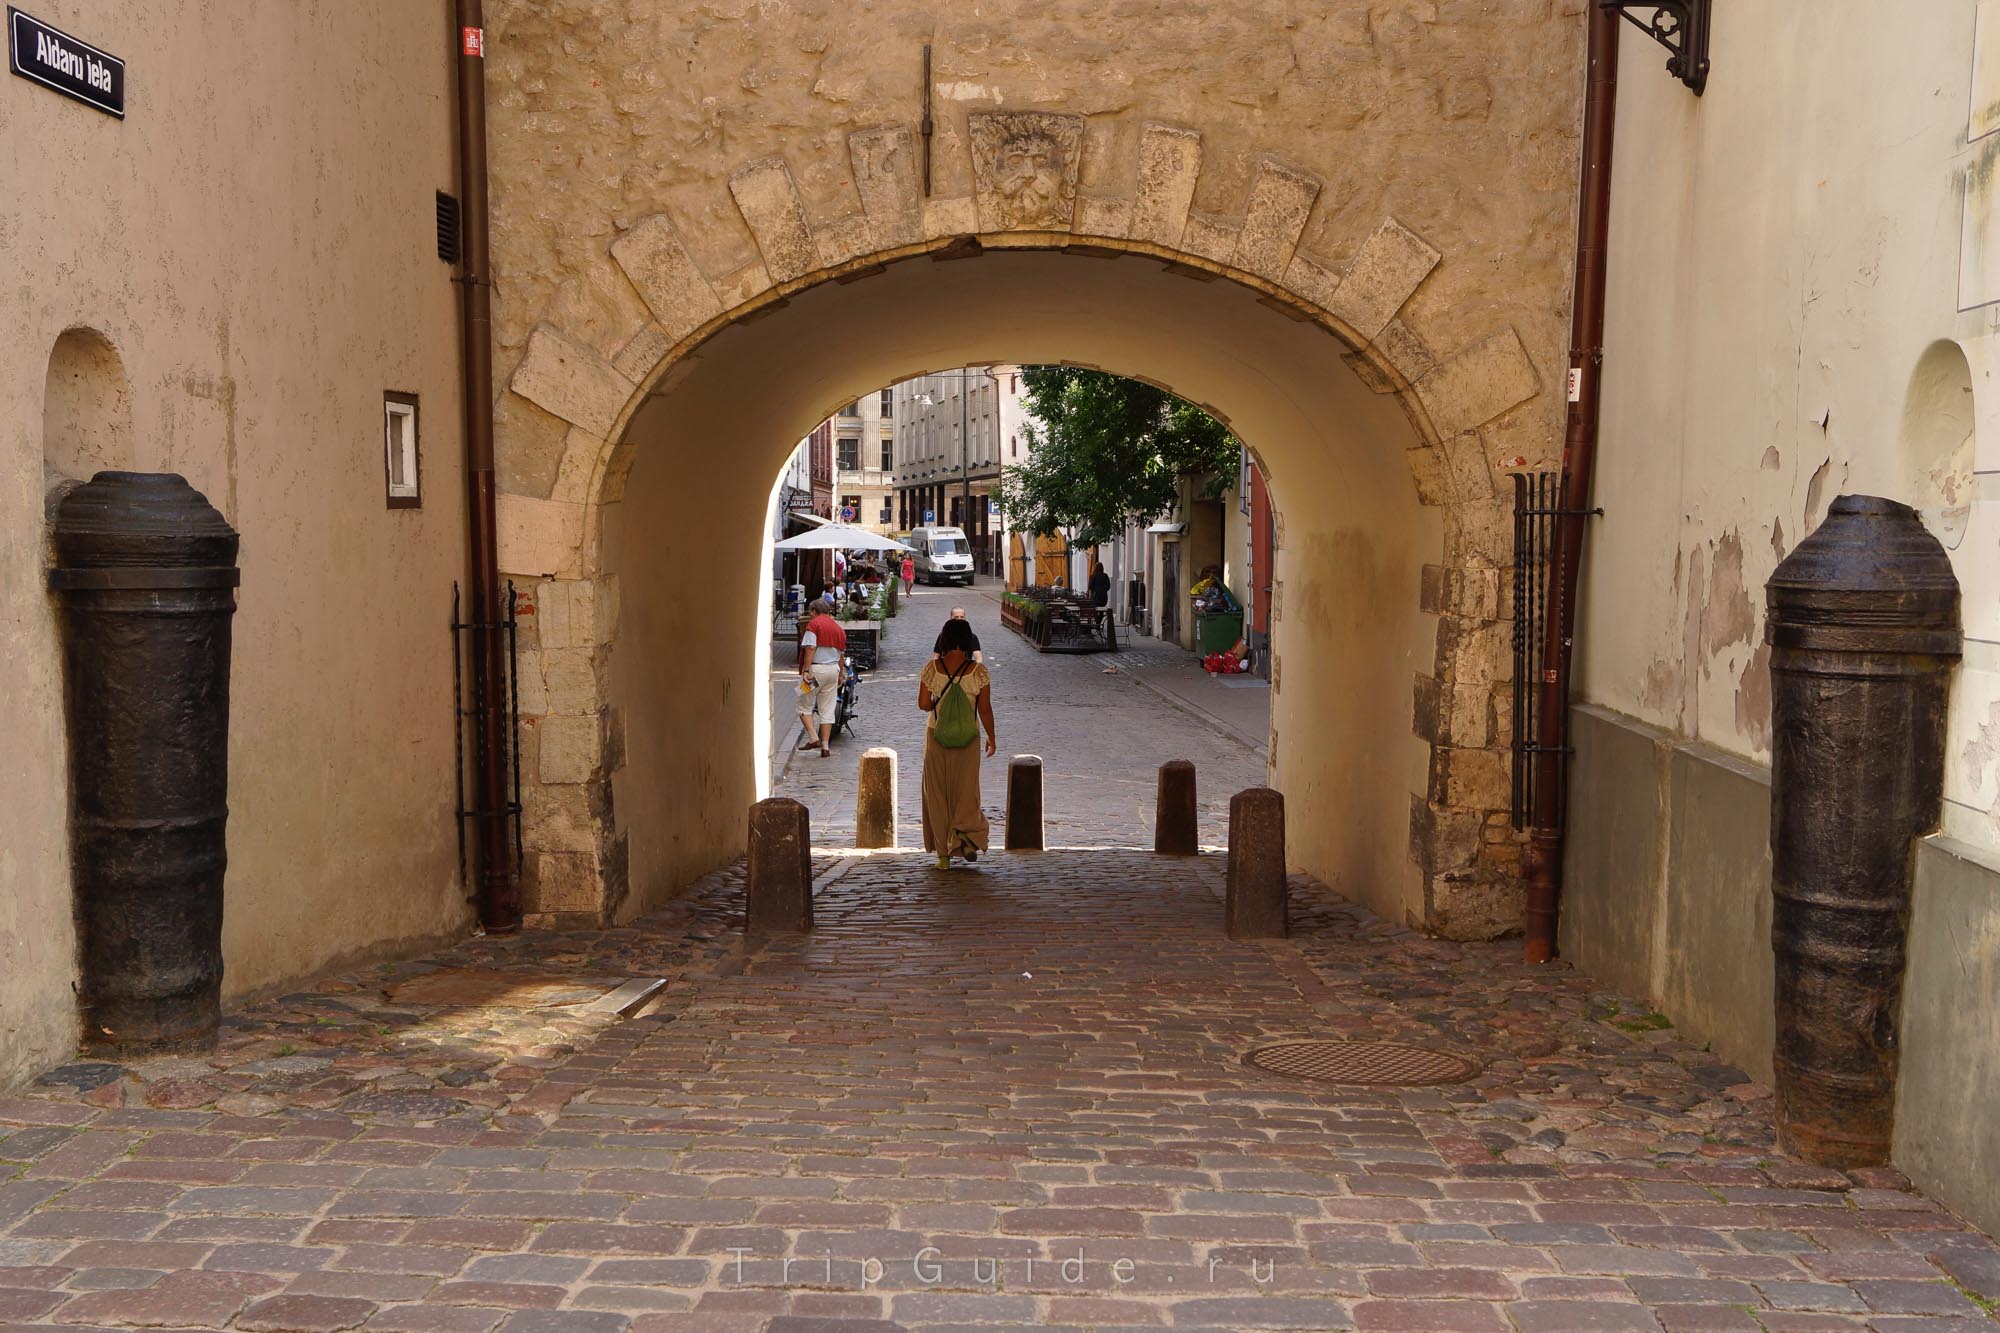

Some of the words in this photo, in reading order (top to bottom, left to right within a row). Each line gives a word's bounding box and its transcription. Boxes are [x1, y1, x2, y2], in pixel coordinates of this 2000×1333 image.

[36, 31, 84, 80] Aldaru
[86, 54, 111, 93] iela
[926, 512, 933, 521] P
